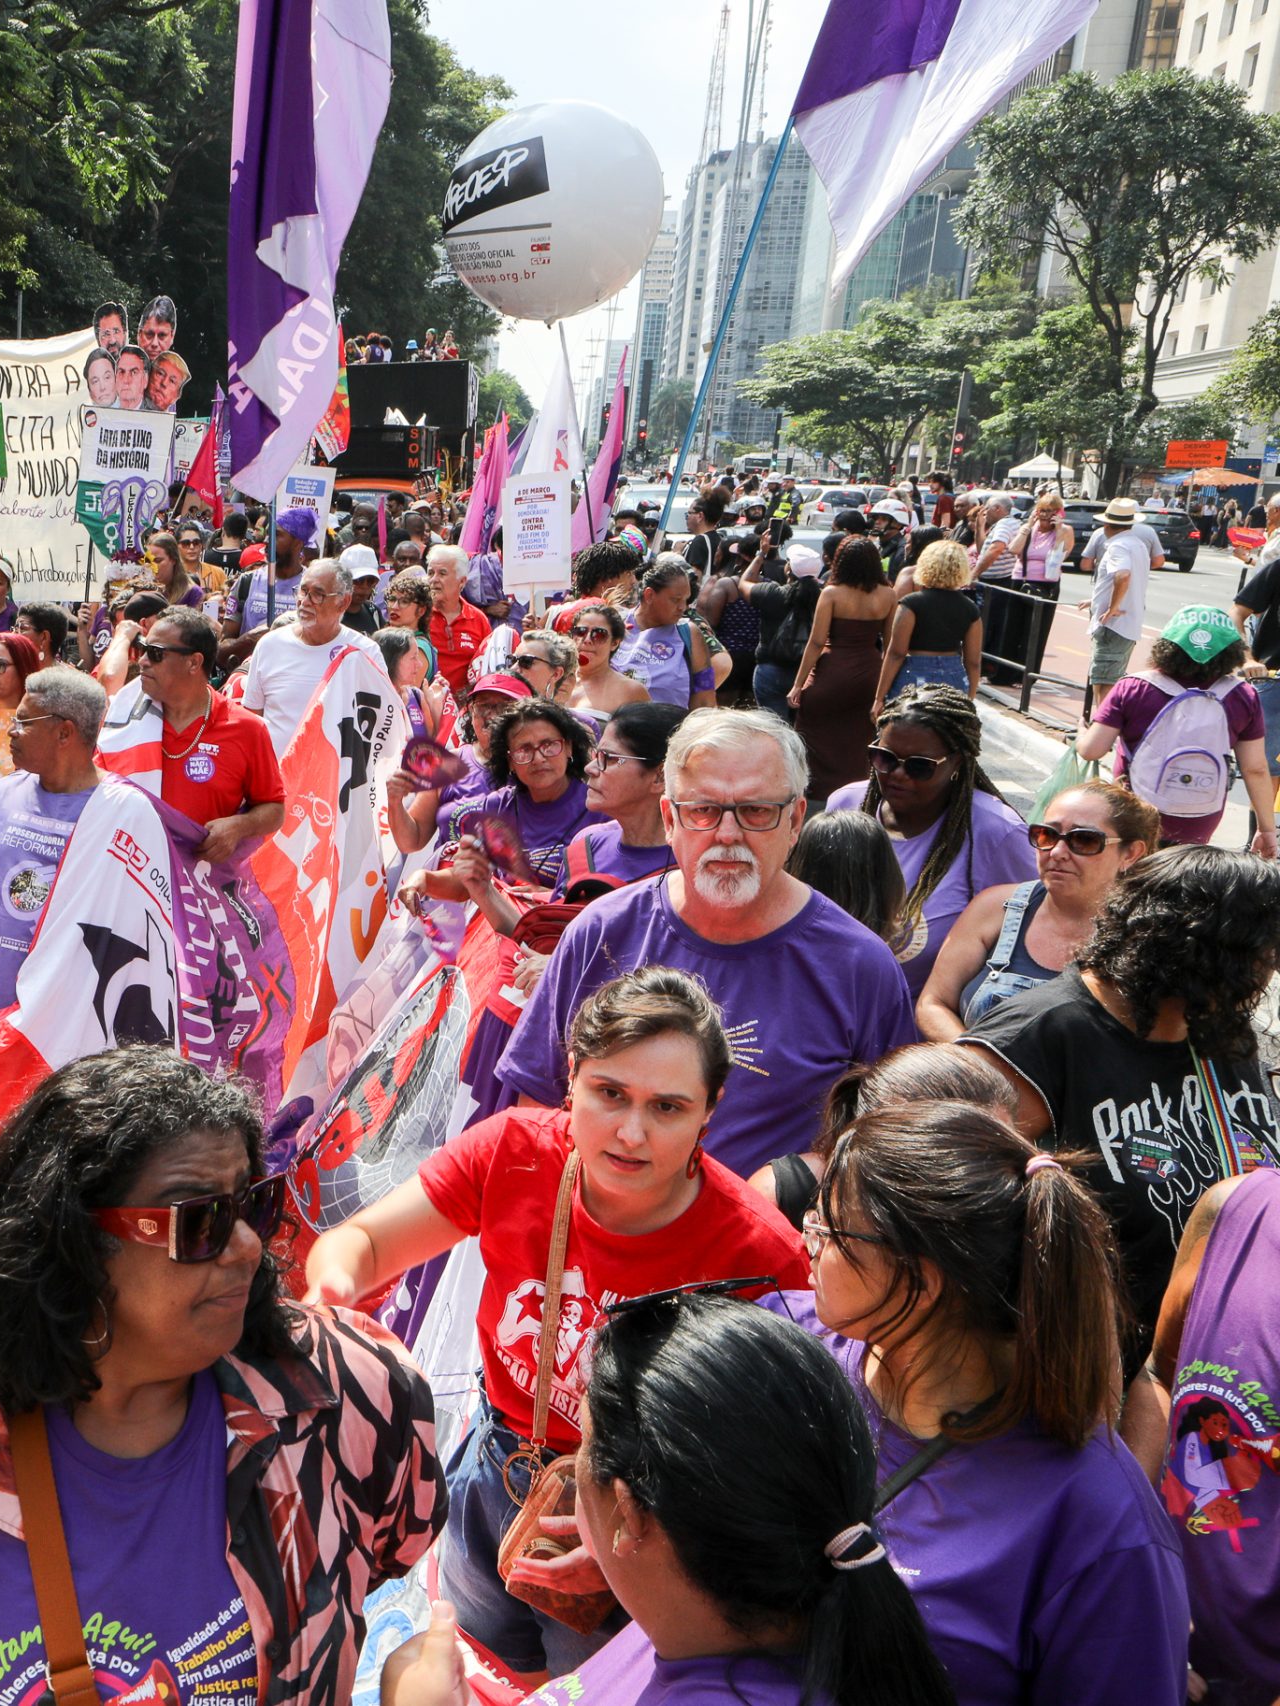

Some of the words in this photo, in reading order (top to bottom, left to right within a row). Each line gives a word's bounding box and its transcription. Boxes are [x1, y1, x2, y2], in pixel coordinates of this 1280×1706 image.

[467, 251, 486, 260] ENSINO
[487, 249, 515, 259] OFICIAL
[482, 260, 502, 269] PAULO
[66, 365, 80, 397] A
[99, 427, 118, 447] LATA
[119, 429, 131, 447] DE
[132, 429, 152, 450] LIXO
[408, 428, 419, 469] SOM
[96, 448, 108, 468] DA
[109, 447, 150, 472] HISTÓRIA
[17, 455, 80, 496] MUNDO
[291, 496, 304, 505] FIM
[306, 498, 316, 506] DA
[530, 486, 551, 494] MARÇO
[521, 517, 544, 525] CONTRA
[1177, 611, 1234, 630] ABORTO
[375, 704, 395, 742] PAULO
[190, 766, 209, 775] MÃE
[1, 834, 59, 858] REFORMA
[6, 826, 66, 847] APOSENTADORIA
[1182, 1074, 1280, 1153] Prty
[1132, 1136, 1172, 1151] PALESTINA
[1208, 1384, 1224, 1396] na
[1224, 1389, 1249, 1413] luta
[1244, 1412, 1267, 1433] por
[82, 1611, 157, 1661] Aqui!
[166, 1622, 220, 1663] Igualdade
[218, 1608, 232, 1625] de
[175, 1640, 227, 1674] Trabalho
[226, 1620, 252, 1642] dece
[108, 1655, 140, 1678] por
[177, 1670, 202, 1688] Fim
[203, 1663, 220, 1681] da
[221, 1645, 258, 1673] jornad
[193, 1680, 240, 1698] Justiça
